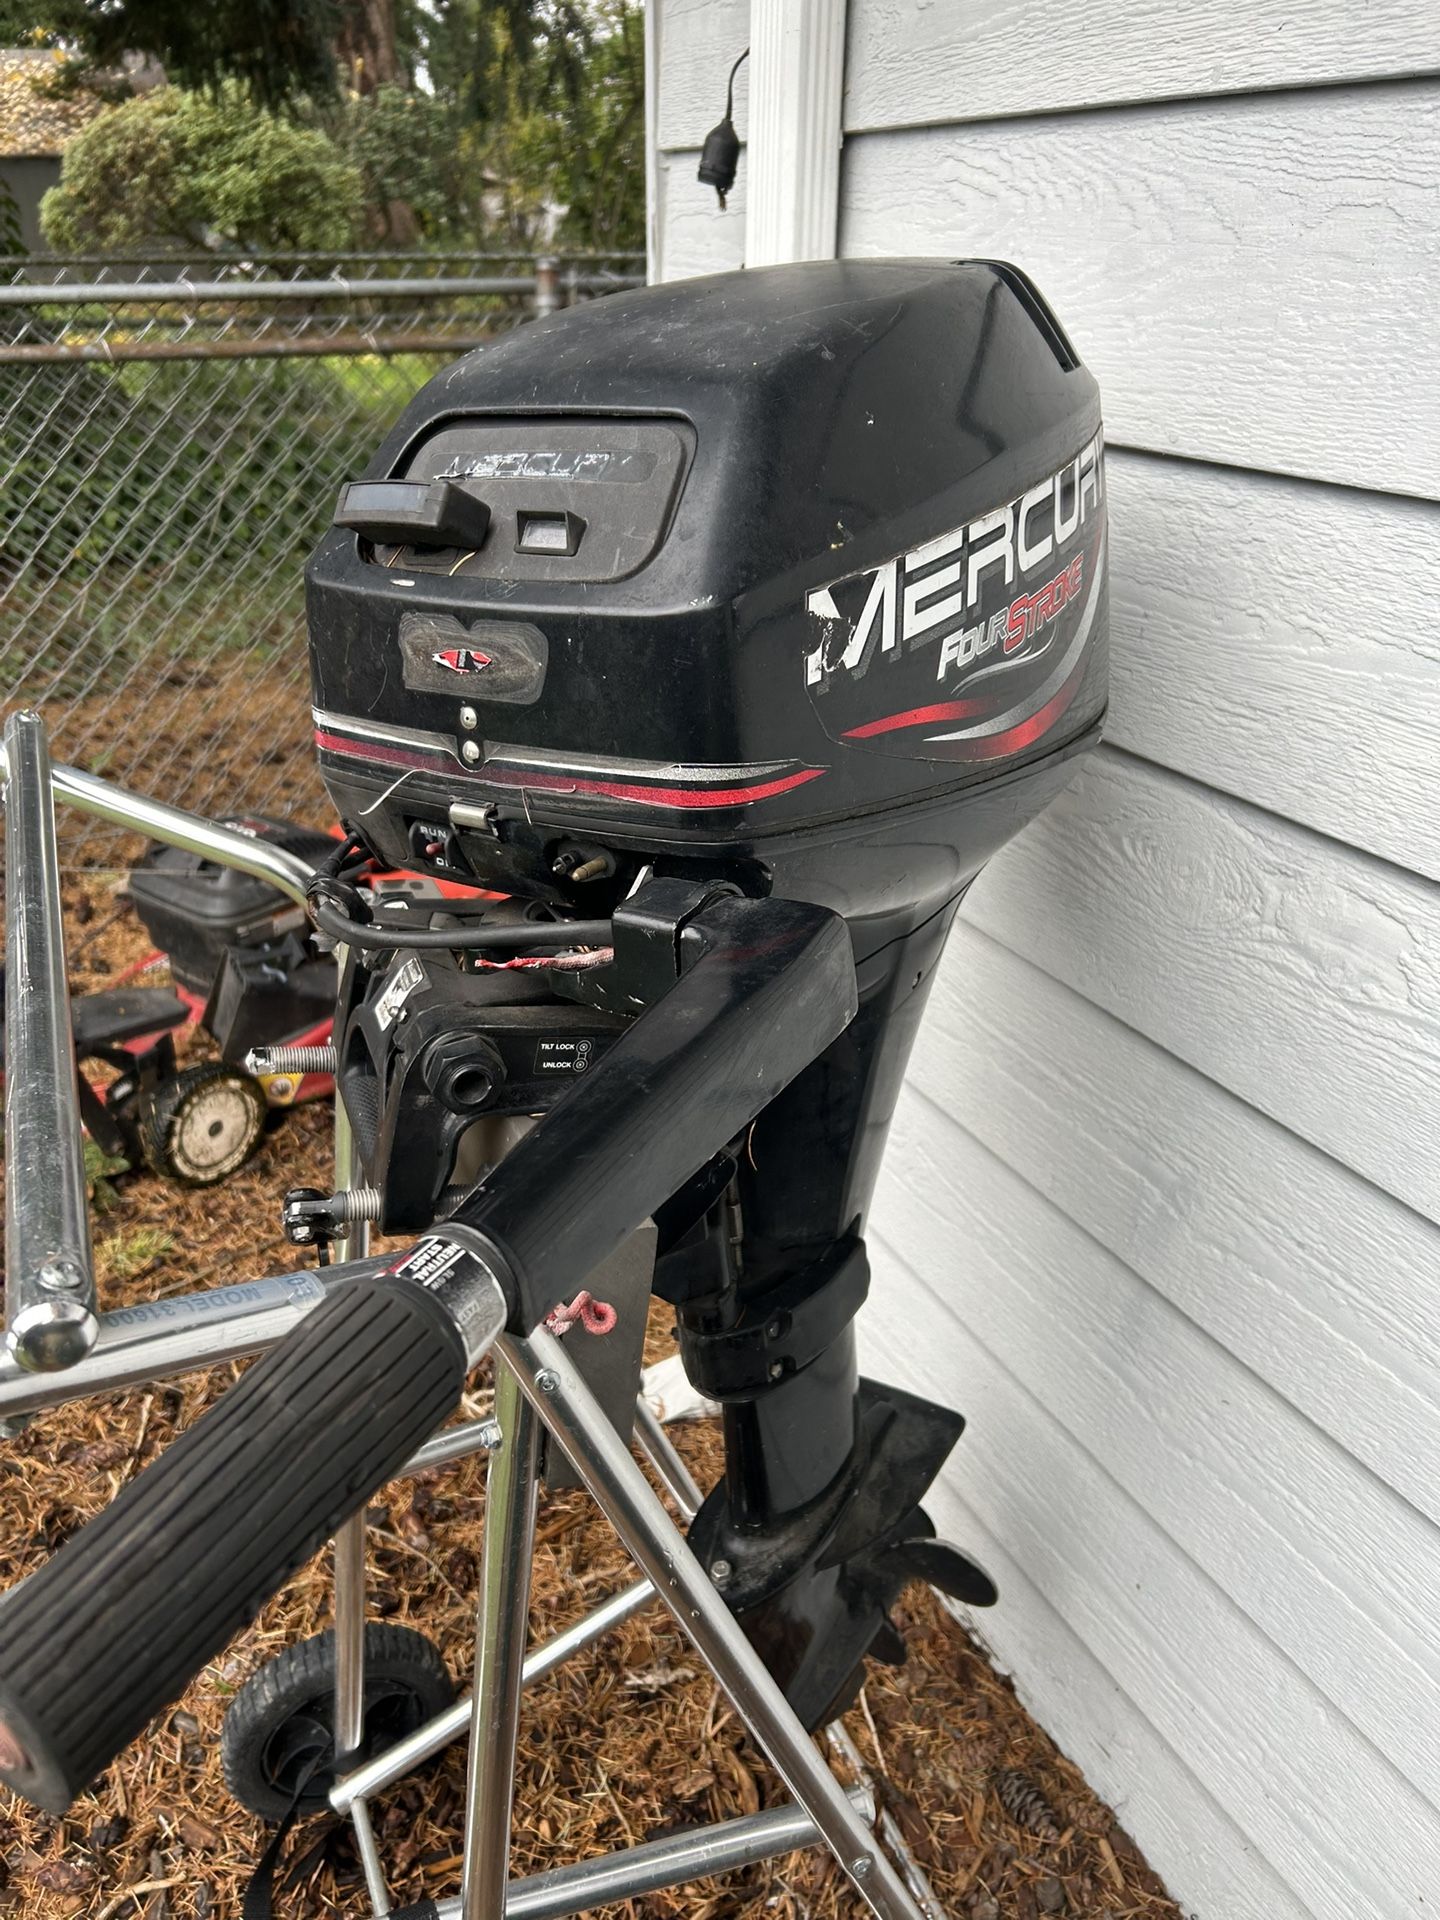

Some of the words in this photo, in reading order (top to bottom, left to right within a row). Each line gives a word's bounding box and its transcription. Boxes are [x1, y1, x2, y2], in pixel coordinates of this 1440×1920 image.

[420, 825, 447, 838] RUN
[408, 1243, 443, 1271] START
[412, 1242, 461, 1281] NEUTRAL
[177, 1284, 264, 1313] MODEL
